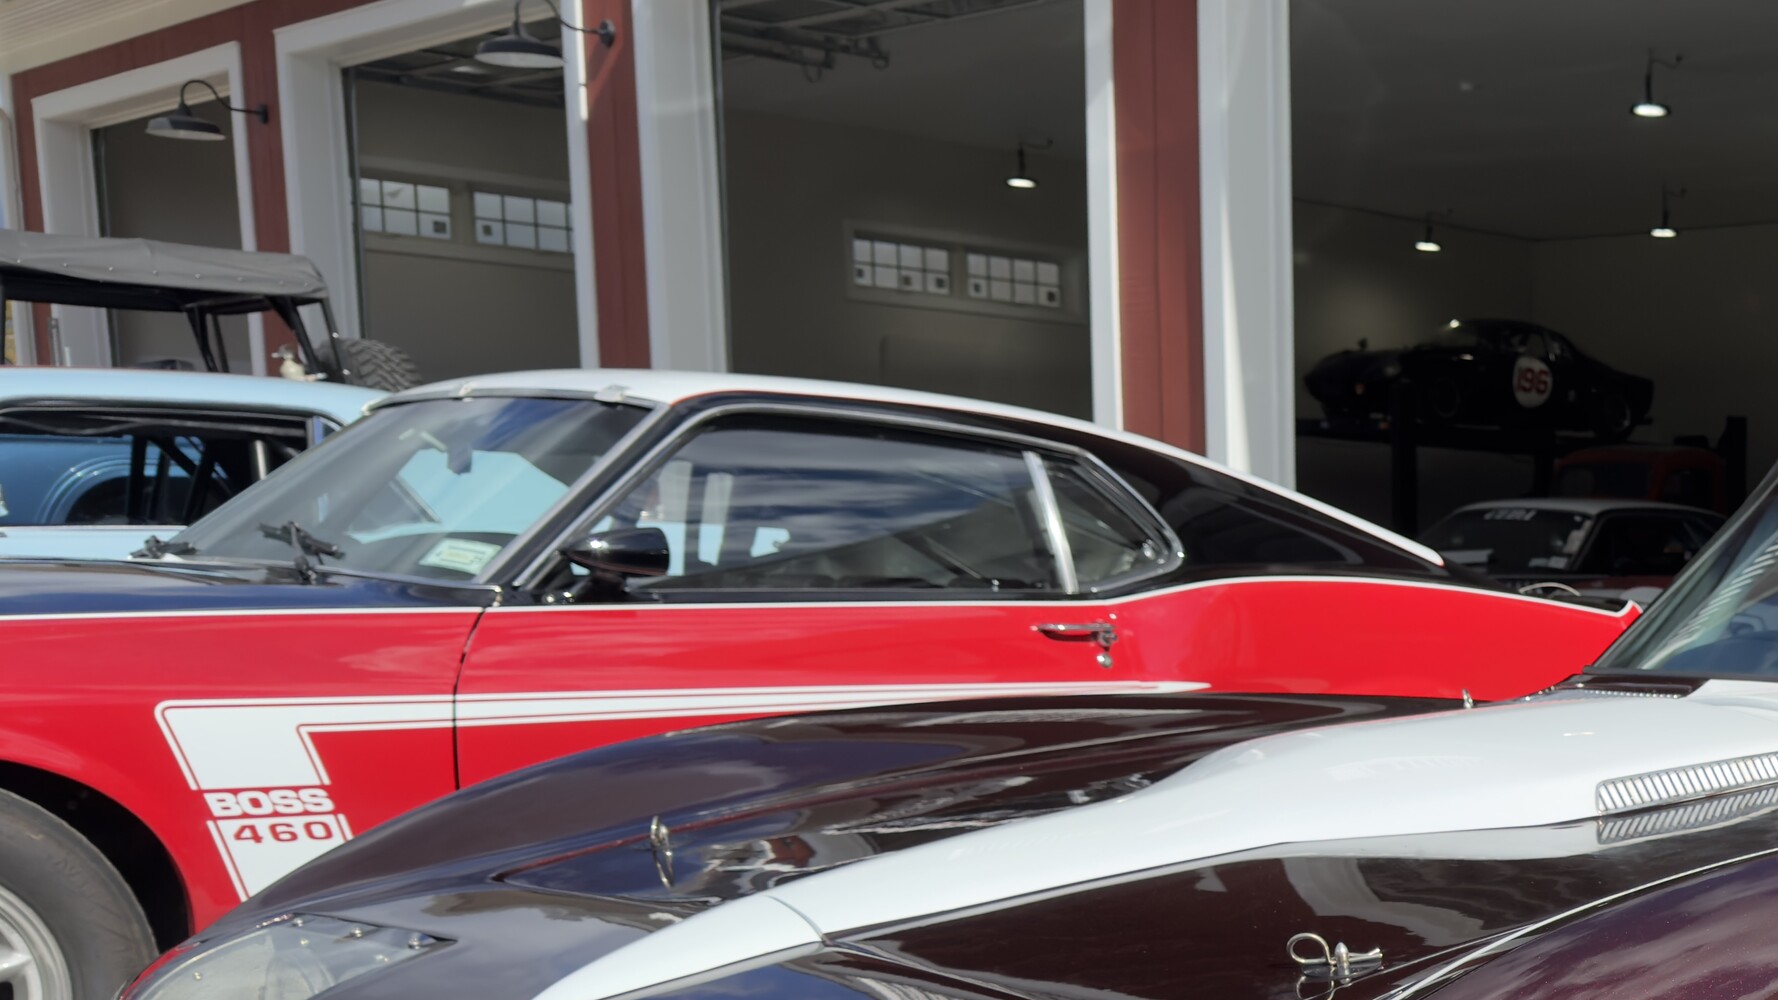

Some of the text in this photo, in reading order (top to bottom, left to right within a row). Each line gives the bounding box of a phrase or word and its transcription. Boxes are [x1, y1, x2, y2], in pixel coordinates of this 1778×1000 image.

[1517, 367, 1549, 395] 196
[203, 788, 335, 817] BOSS
[233, 821, 334, 843] 460
